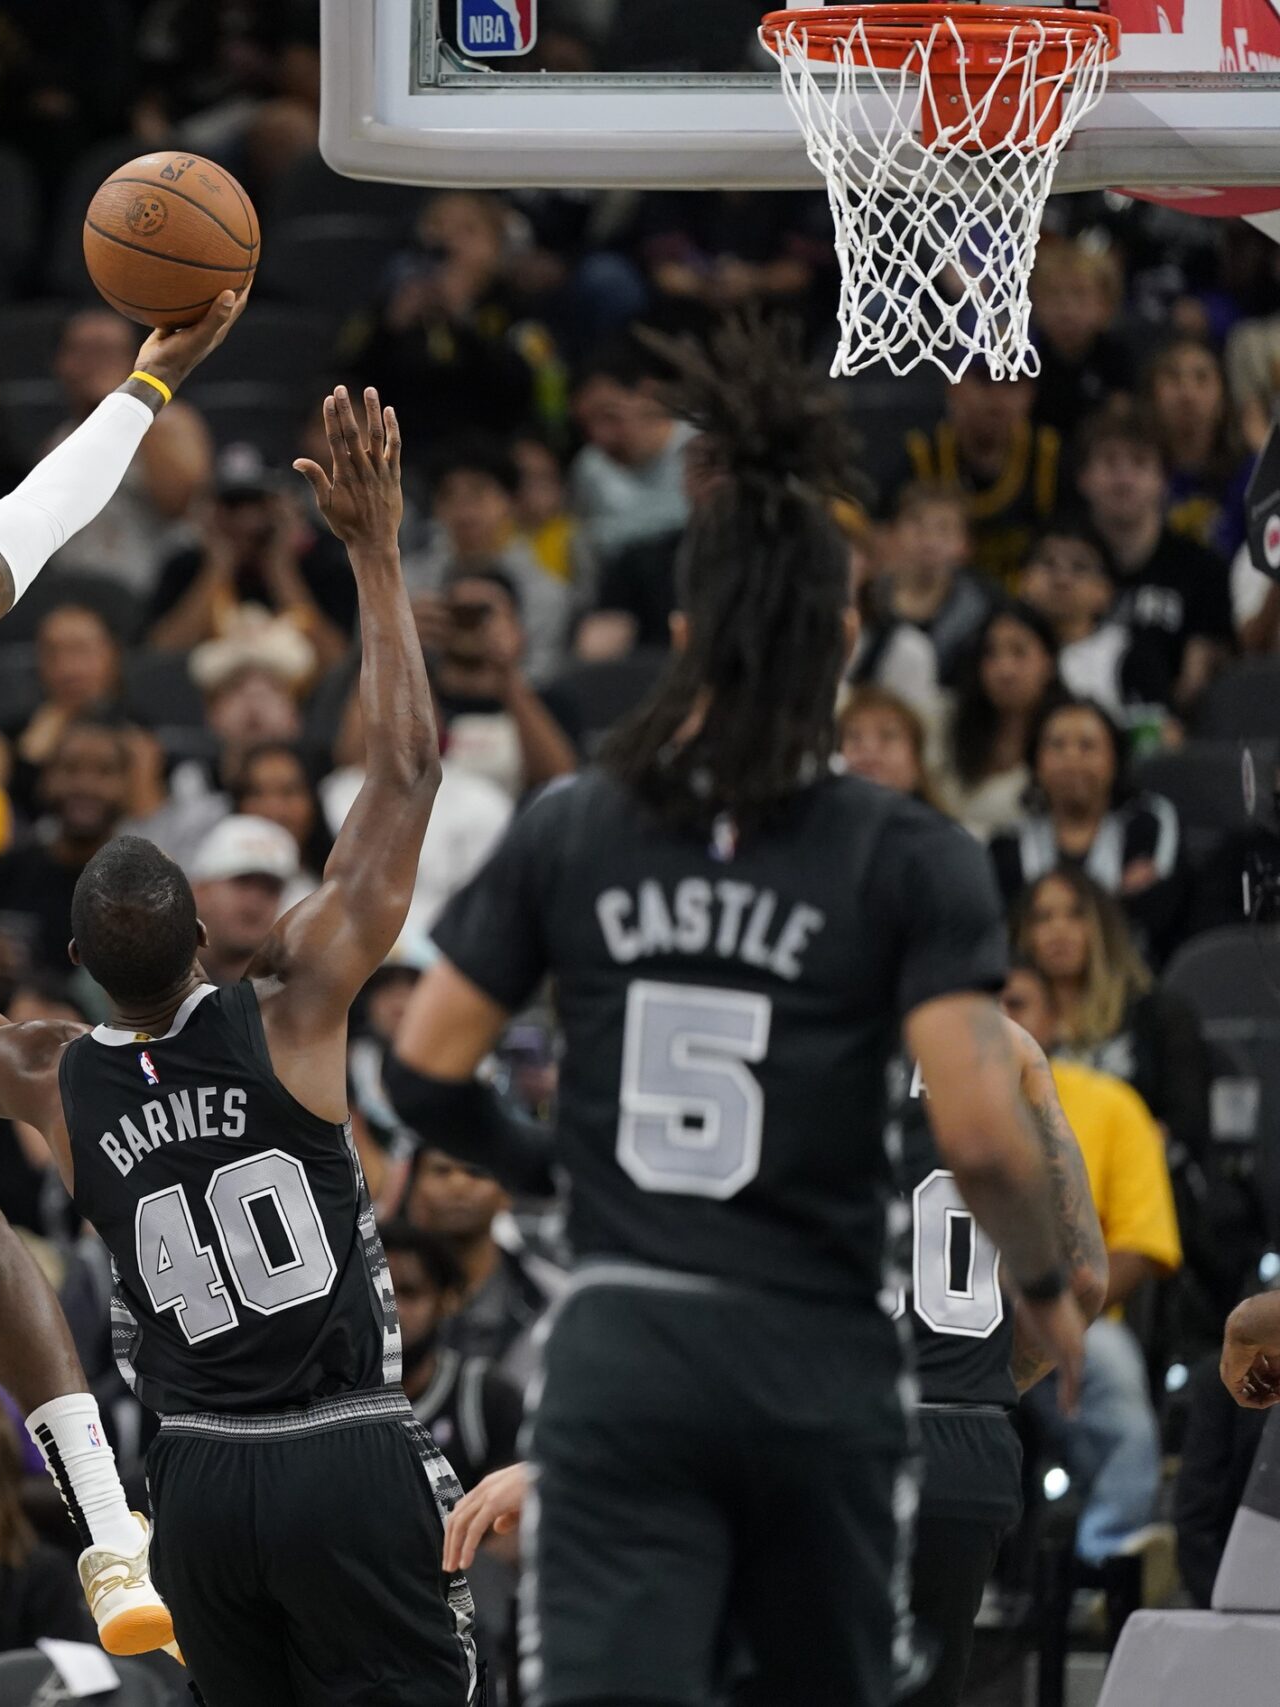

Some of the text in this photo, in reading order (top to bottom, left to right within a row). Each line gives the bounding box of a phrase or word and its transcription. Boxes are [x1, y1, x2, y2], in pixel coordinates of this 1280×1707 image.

[469, 15, 506, 44] NBA
[596, 877, 825, 981] CASTLE
[99, 1086, 247, 1177] BARNES
[615, 979, 772, 1200] 5
[135, 1148, 338, 1345] 40
